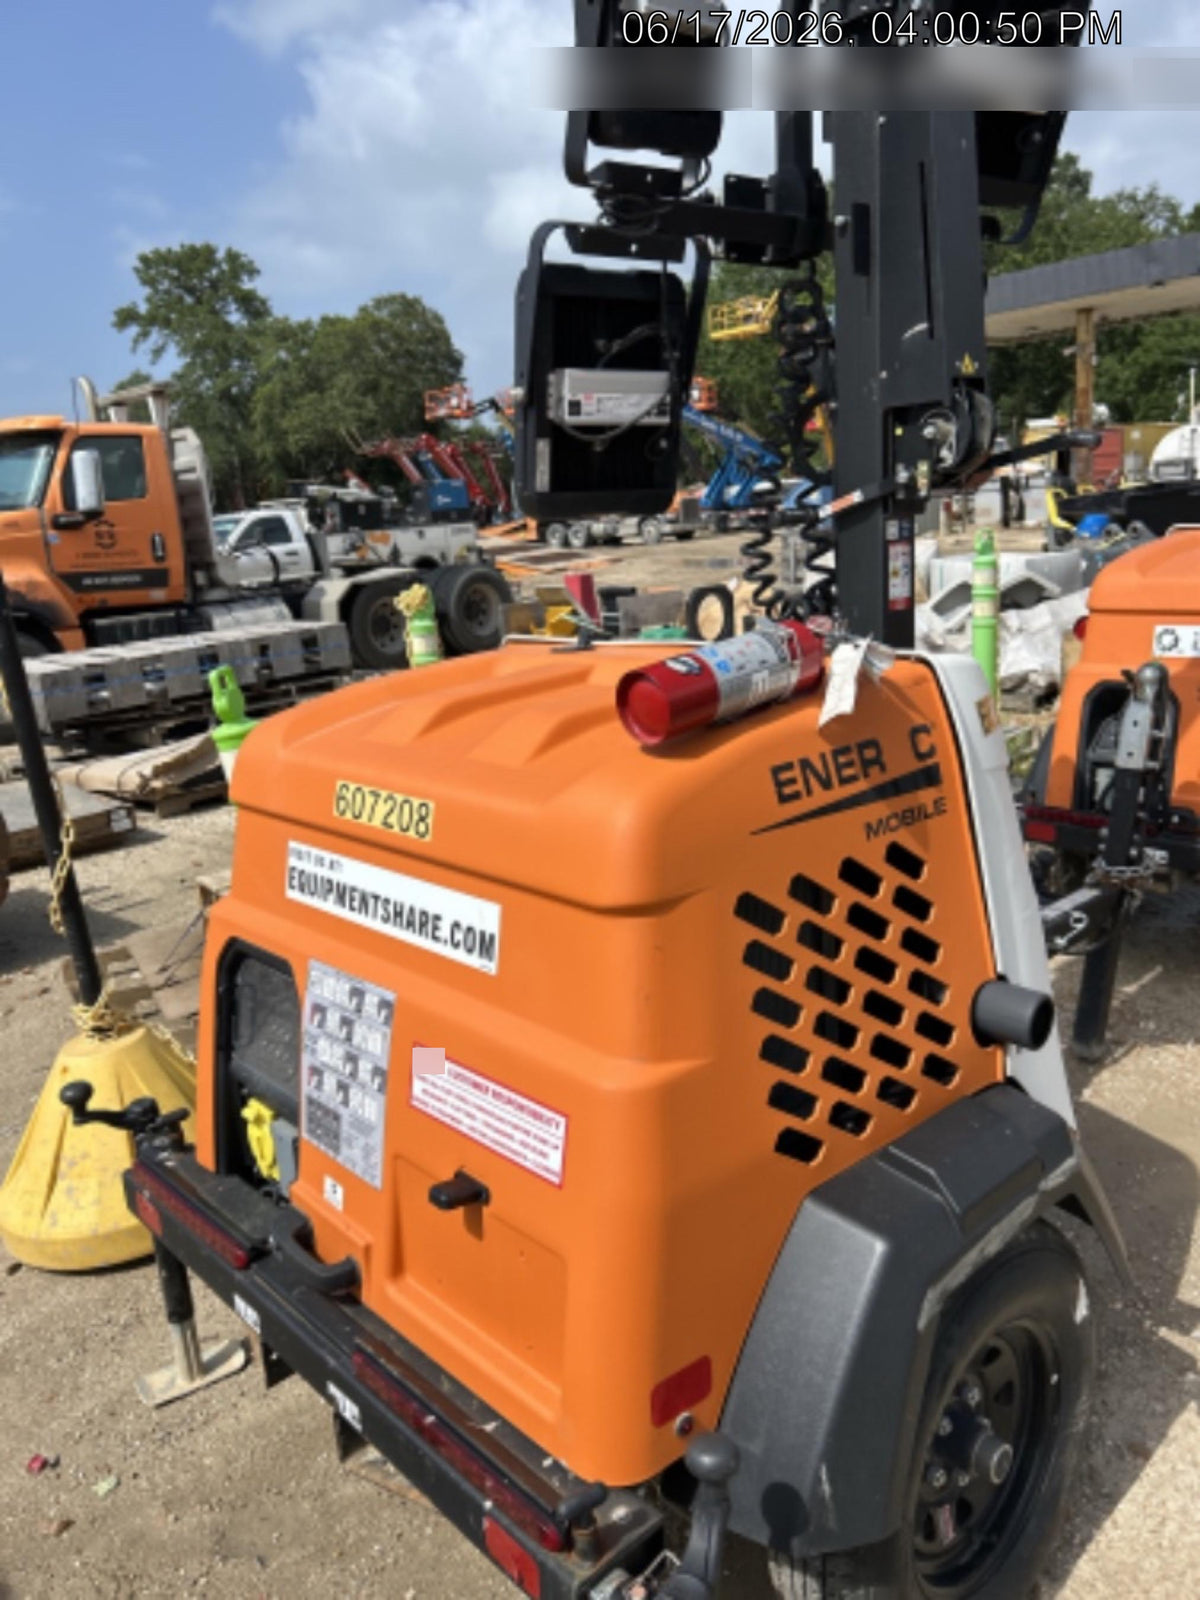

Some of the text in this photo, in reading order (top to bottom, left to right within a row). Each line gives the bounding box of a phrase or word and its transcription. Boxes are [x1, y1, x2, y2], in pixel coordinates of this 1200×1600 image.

[334, 783, 431, 839] 607208
[864, 797, 947, 841] MOBILE
[287, 866, 496, 962] EQUIPMENTSHARE.COM
